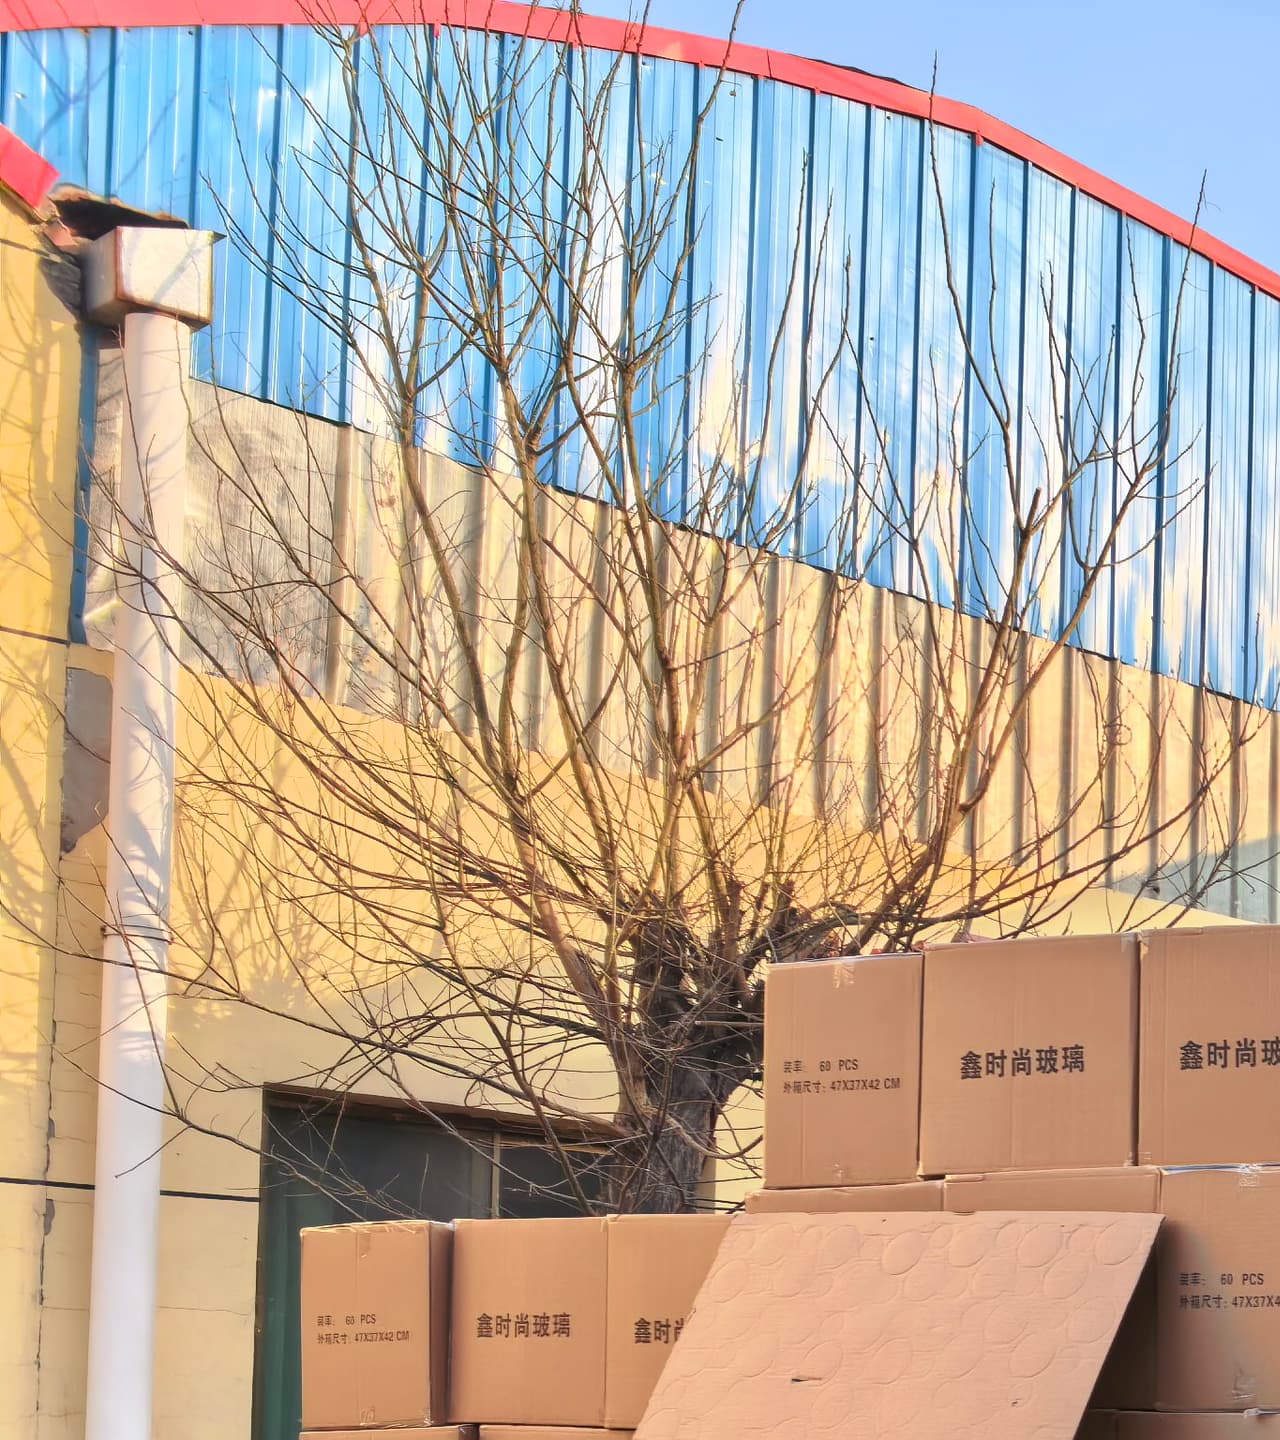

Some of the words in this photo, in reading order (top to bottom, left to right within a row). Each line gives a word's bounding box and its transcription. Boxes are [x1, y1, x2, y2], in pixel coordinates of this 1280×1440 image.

[819, 1059, 831, 1072] 60
[839, 1058, 859, 1071] PCS
[960, 1044, 1085, 1080] 鑫时尚玻璃
[884, 1077, 903, 1090] CM
[1220, 1273, 1233, 1286] 60
[1242, 1273, 1264, 1286] PCS
[360, 1313, 376, 1325] PCS
[477, 1312, 571, 1338] 鑫时尚玻璃
